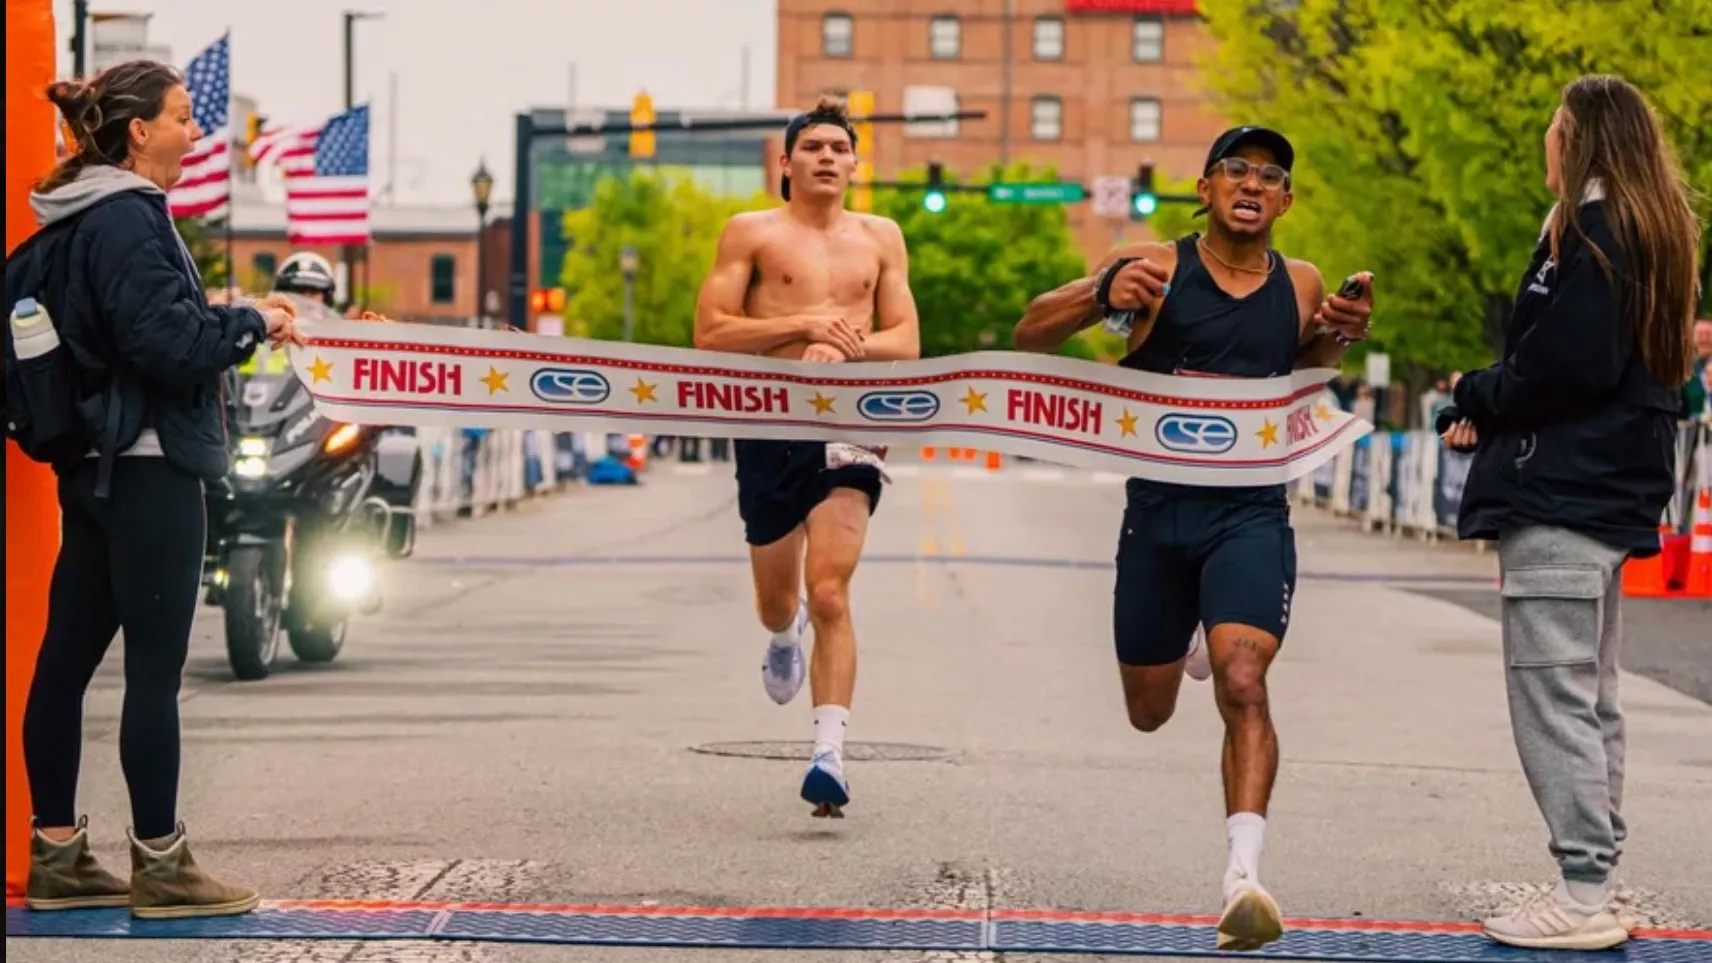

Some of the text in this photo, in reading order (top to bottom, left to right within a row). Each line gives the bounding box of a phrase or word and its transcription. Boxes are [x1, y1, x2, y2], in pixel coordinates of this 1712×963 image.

[353, 358, 462, 395] FINISH
[678, 380, 789, 413] FINISH
[1006, 388, 1103, 434] FINISH
